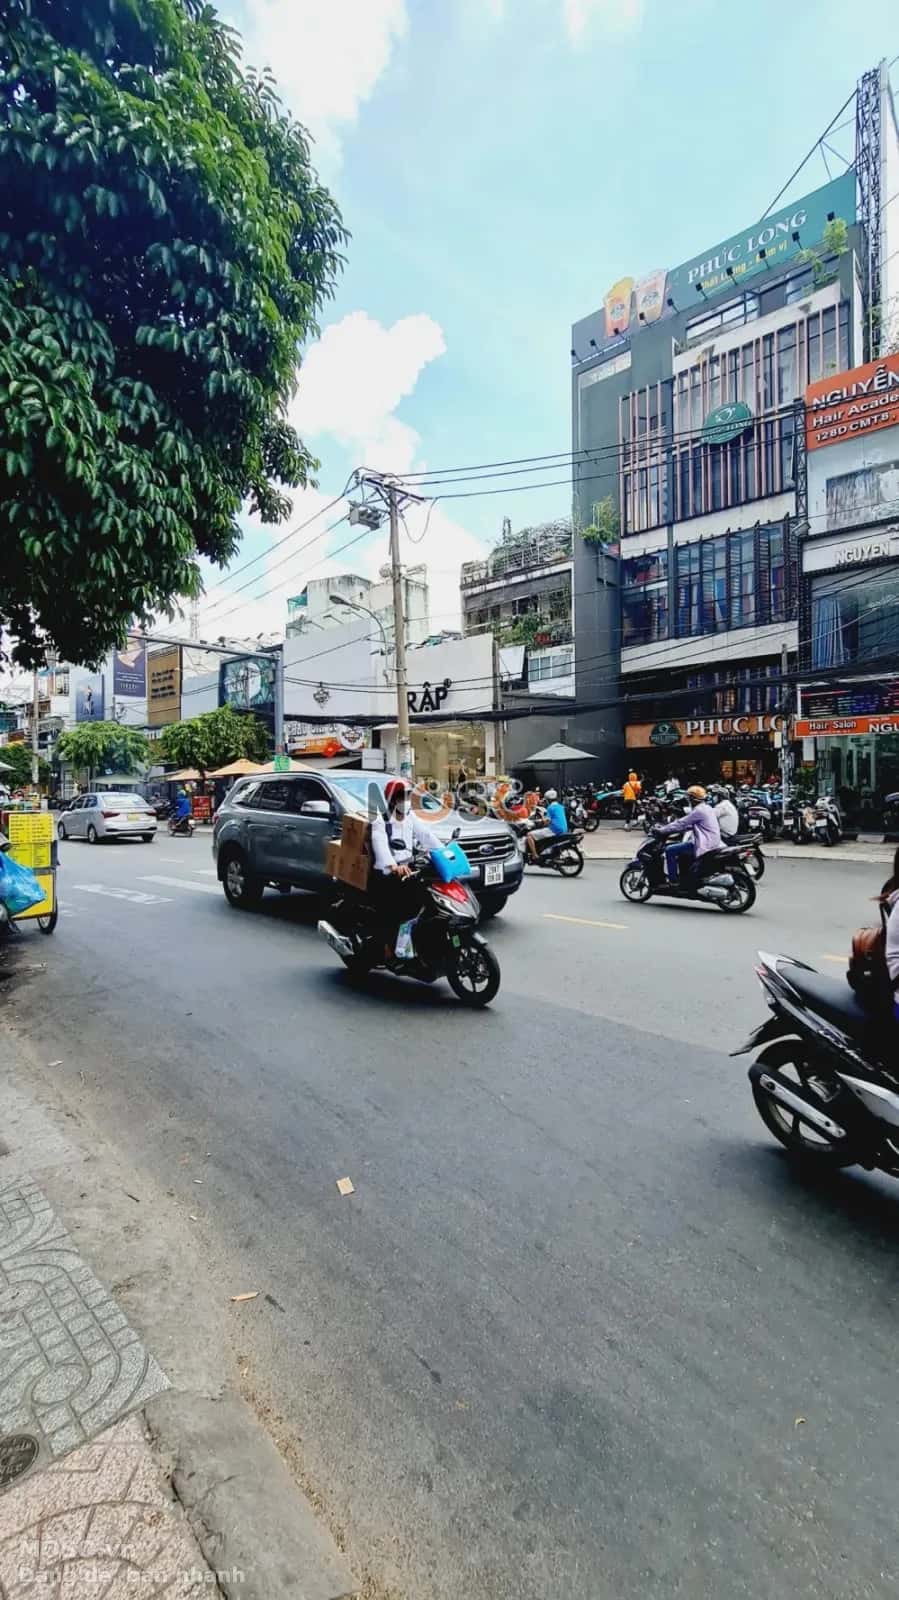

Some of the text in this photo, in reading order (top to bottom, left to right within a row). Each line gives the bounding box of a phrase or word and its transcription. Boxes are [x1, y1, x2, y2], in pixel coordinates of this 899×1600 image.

[747, 209, 808, 252] LONG
[812, 410, 845, 428] Hair
[816, 425, 848, 441] 128D
[809, 721, 829, 730] Hair
[832, 719, 857, 729] Salon
